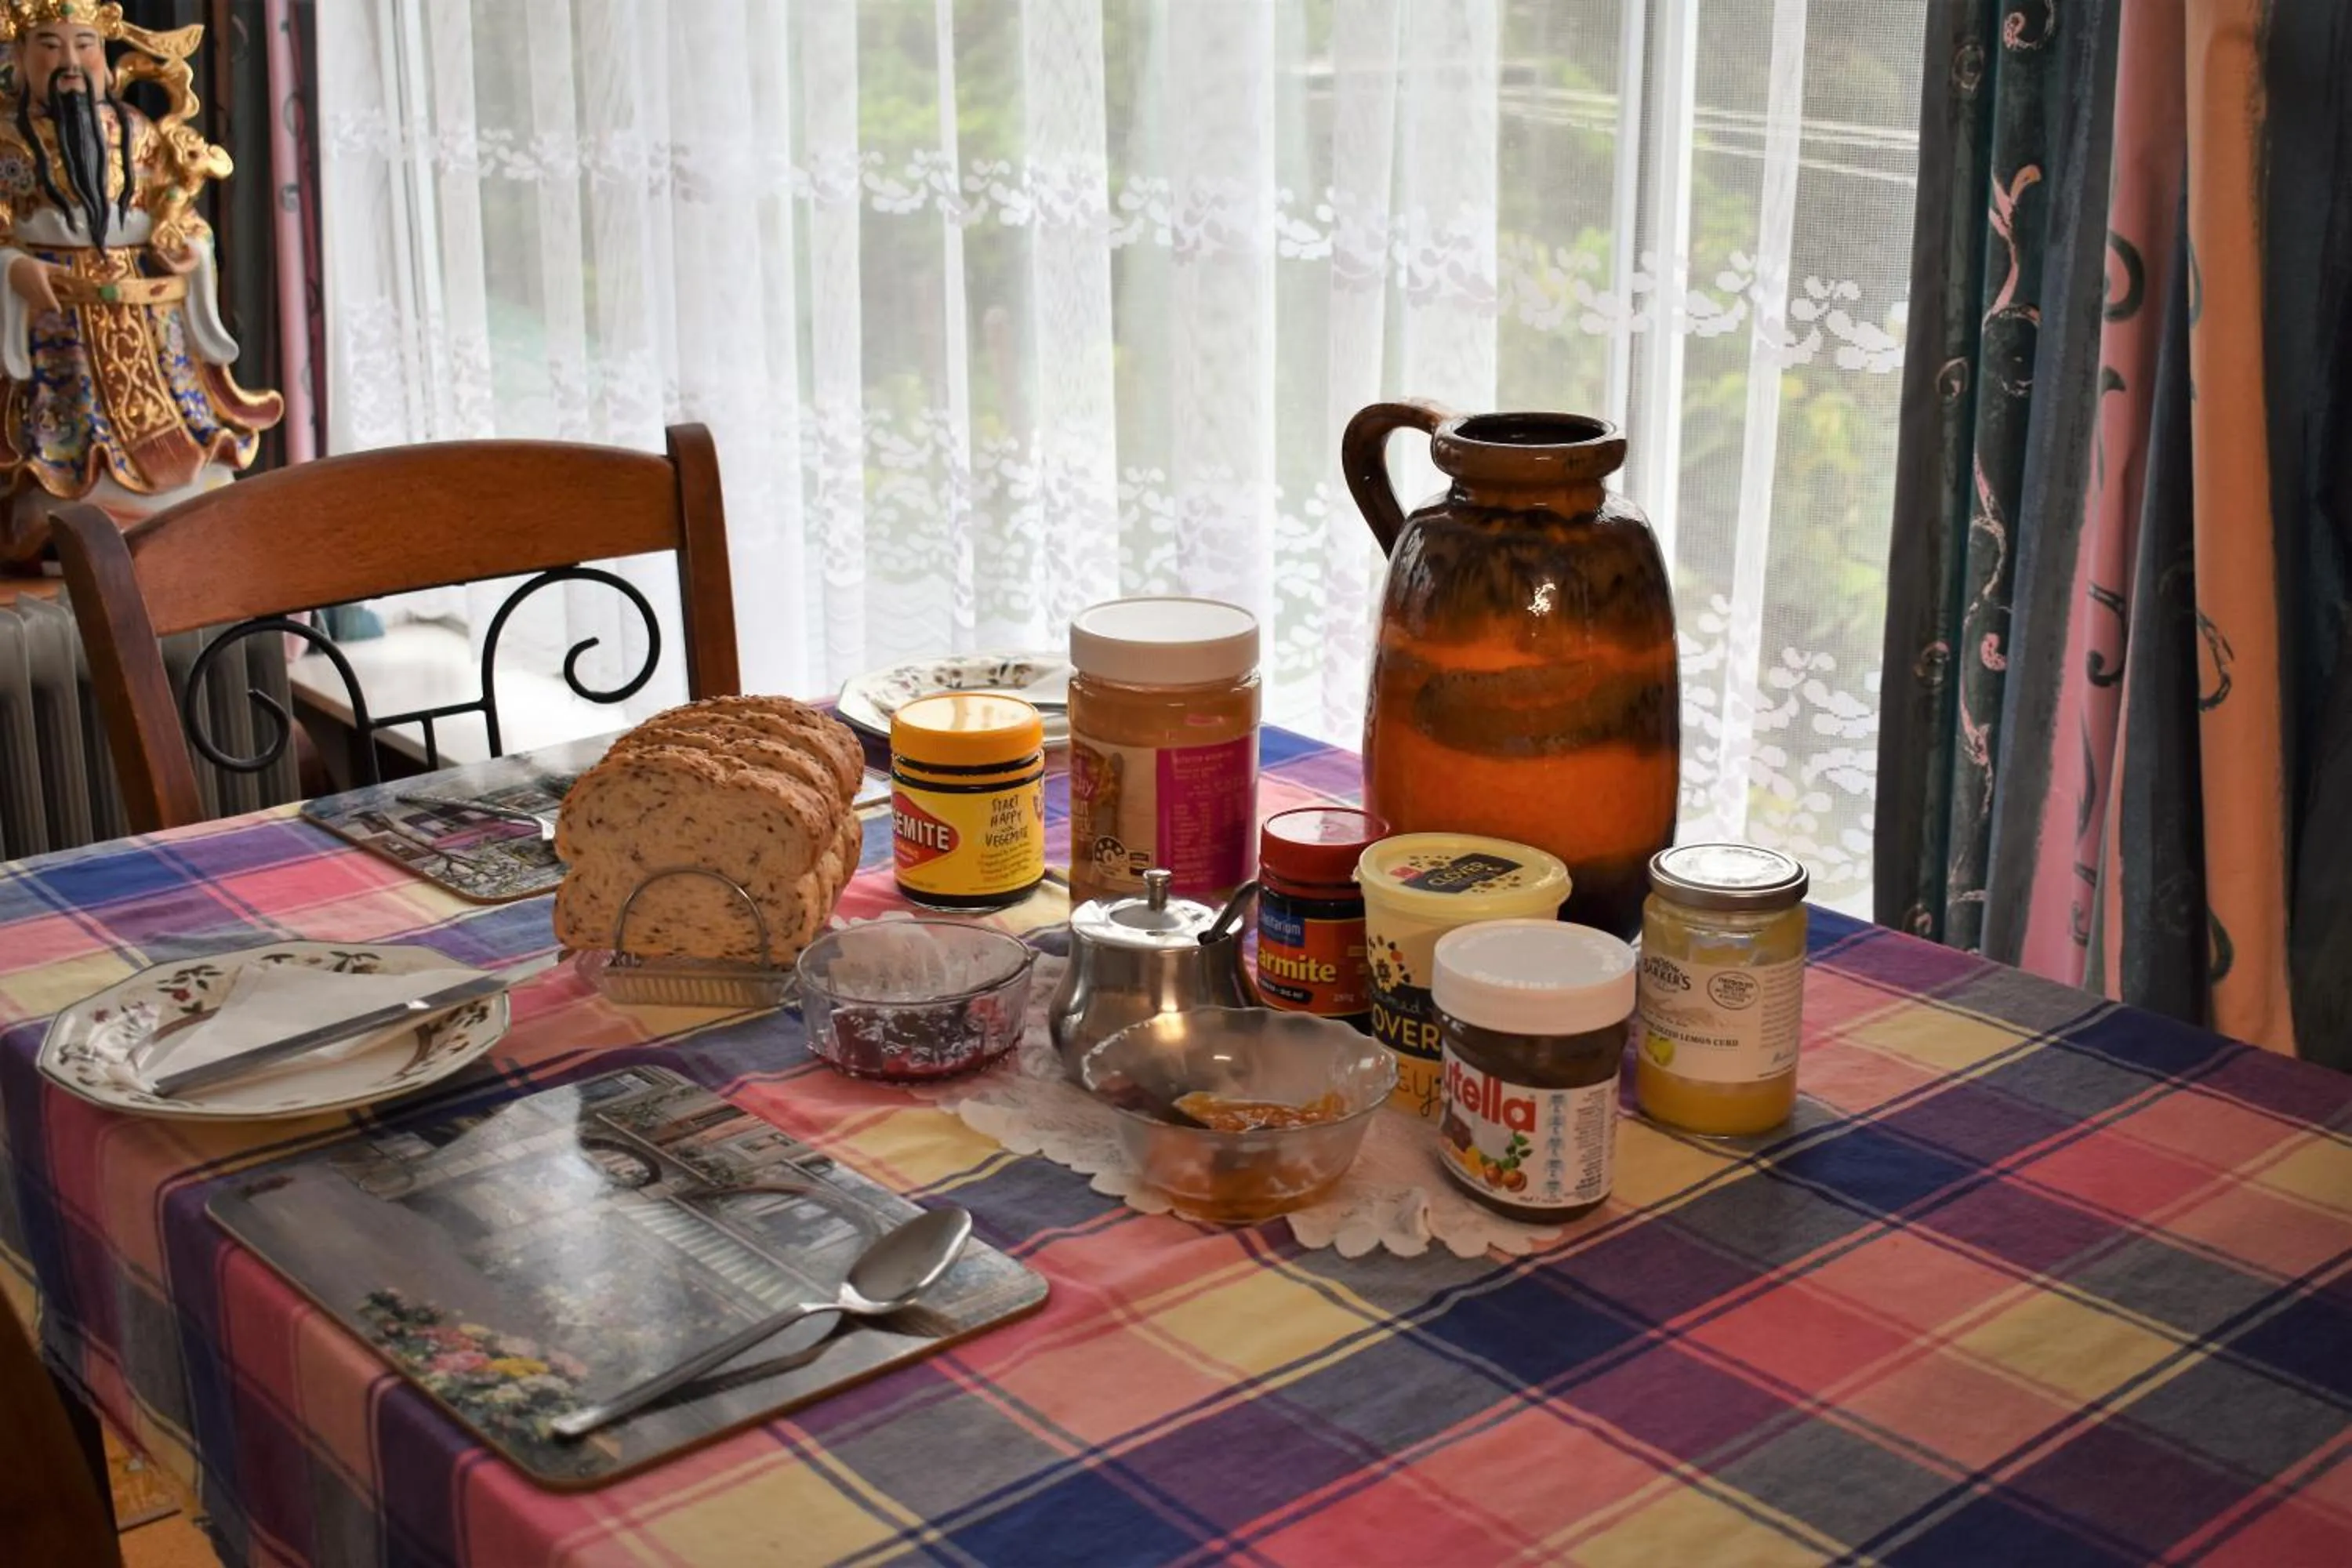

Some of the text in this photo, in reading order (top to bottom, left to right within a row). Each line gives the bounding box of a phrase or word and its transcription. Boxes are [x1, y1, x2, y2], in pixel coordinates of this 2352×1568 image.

[991, 793, 1019, 813] START
[990, 810, 1023, 829] HAPPY
[985, 826, 1029, 848] VEGEMITE
[1680, 1033, 1712, 1047] LEMON
